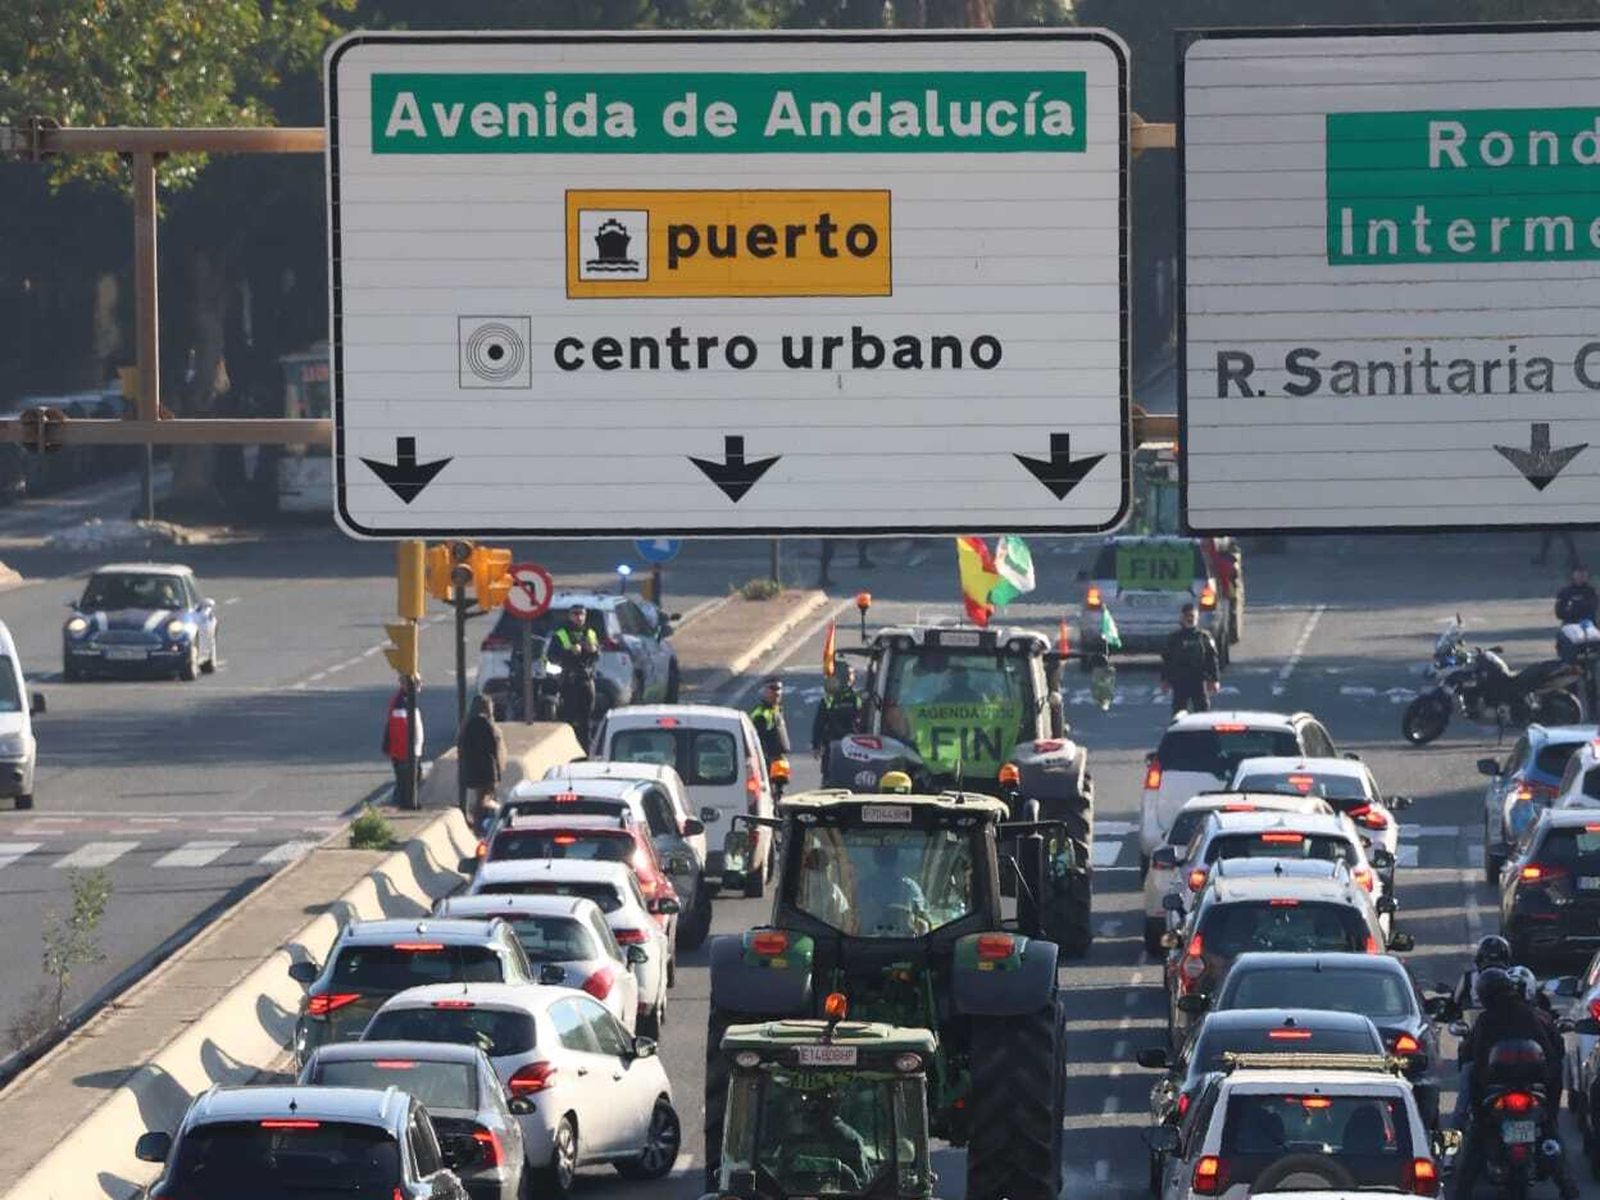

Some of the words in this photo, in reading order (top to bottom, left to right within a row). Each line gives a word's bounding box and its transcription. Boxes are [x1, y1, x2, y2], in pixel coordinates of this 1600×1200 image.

[384, 91, 638, 139] Avenida
[661, 91, 738, 138] de
[764, 89, 1076, 138] Andalucía
[1428, 116, 1600, 168] Rond
[665, 211, 879, 269] puerto
[553, 326, 759, 371] centro
[782, 325, 1003, 370] urbano
[1130, 558, 1178, 580] FIN
[917, 706, 979, 720] AGENDA
[930, 726, 1003, 762] FIN
